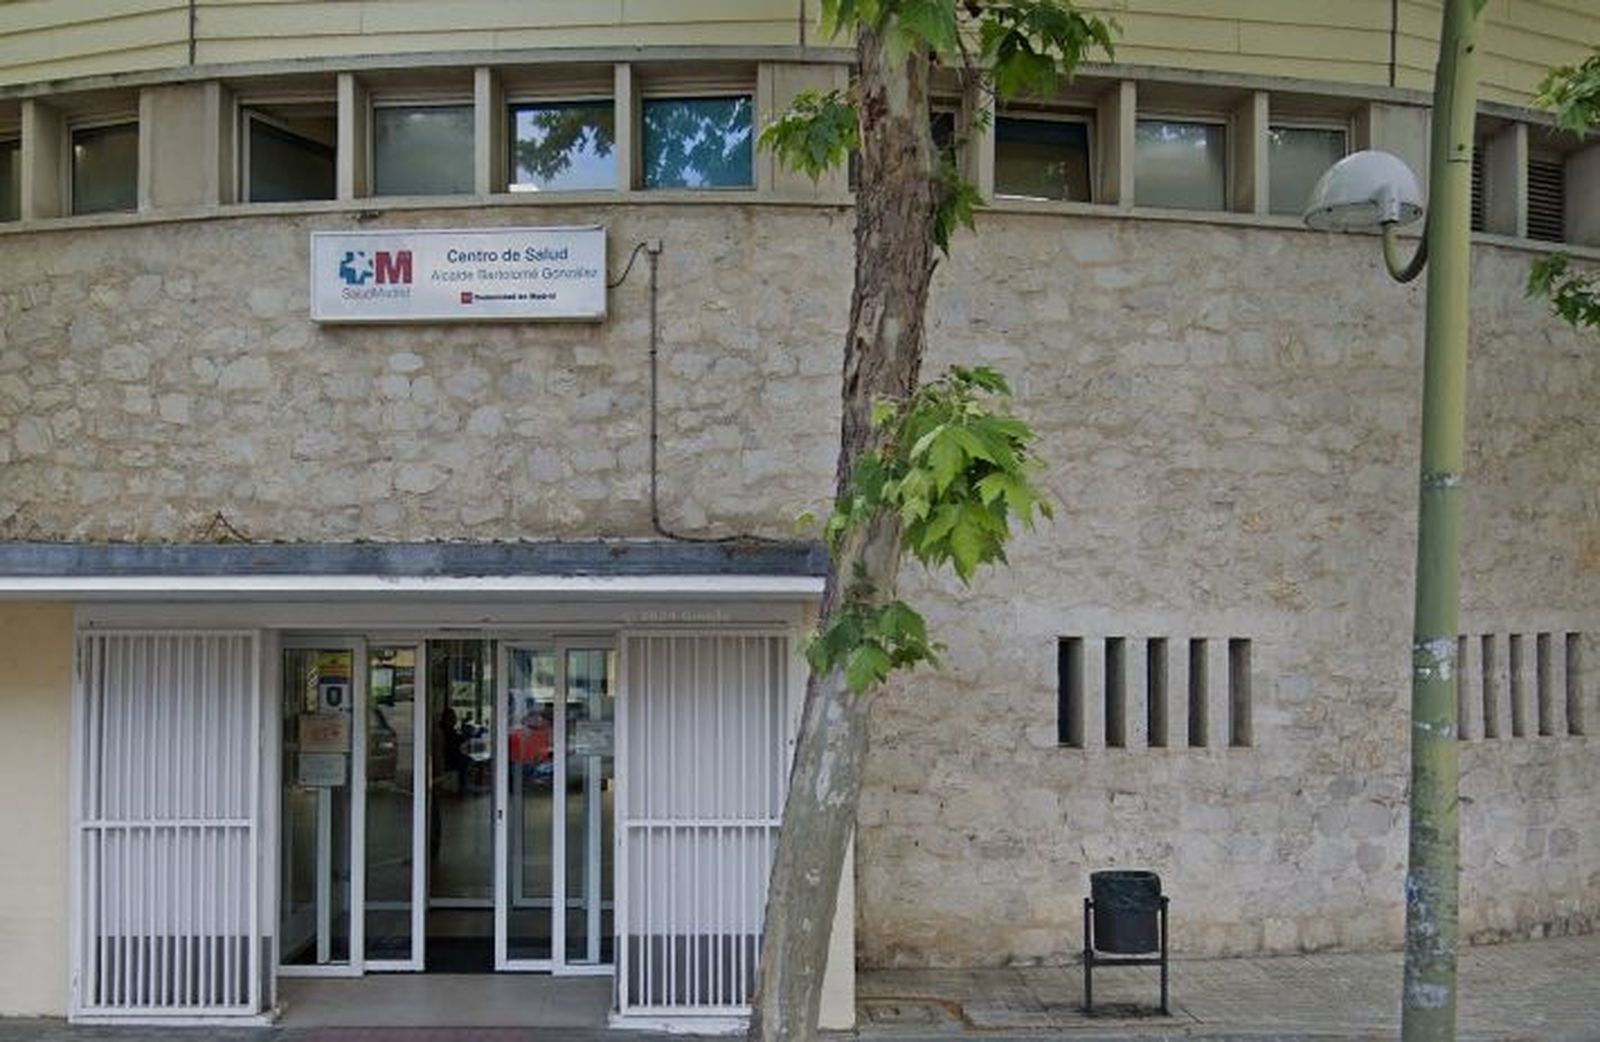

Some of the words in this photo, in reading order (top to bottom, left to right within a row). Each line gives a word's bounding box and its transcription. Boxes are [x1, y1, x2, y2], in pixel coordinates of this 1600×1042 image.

[447, 248, 498, 263] Centro
[501, 249, 521, 262] de
[525, 246, 568, 261] Salud
[431, 269, 474, 281] Alcalde
